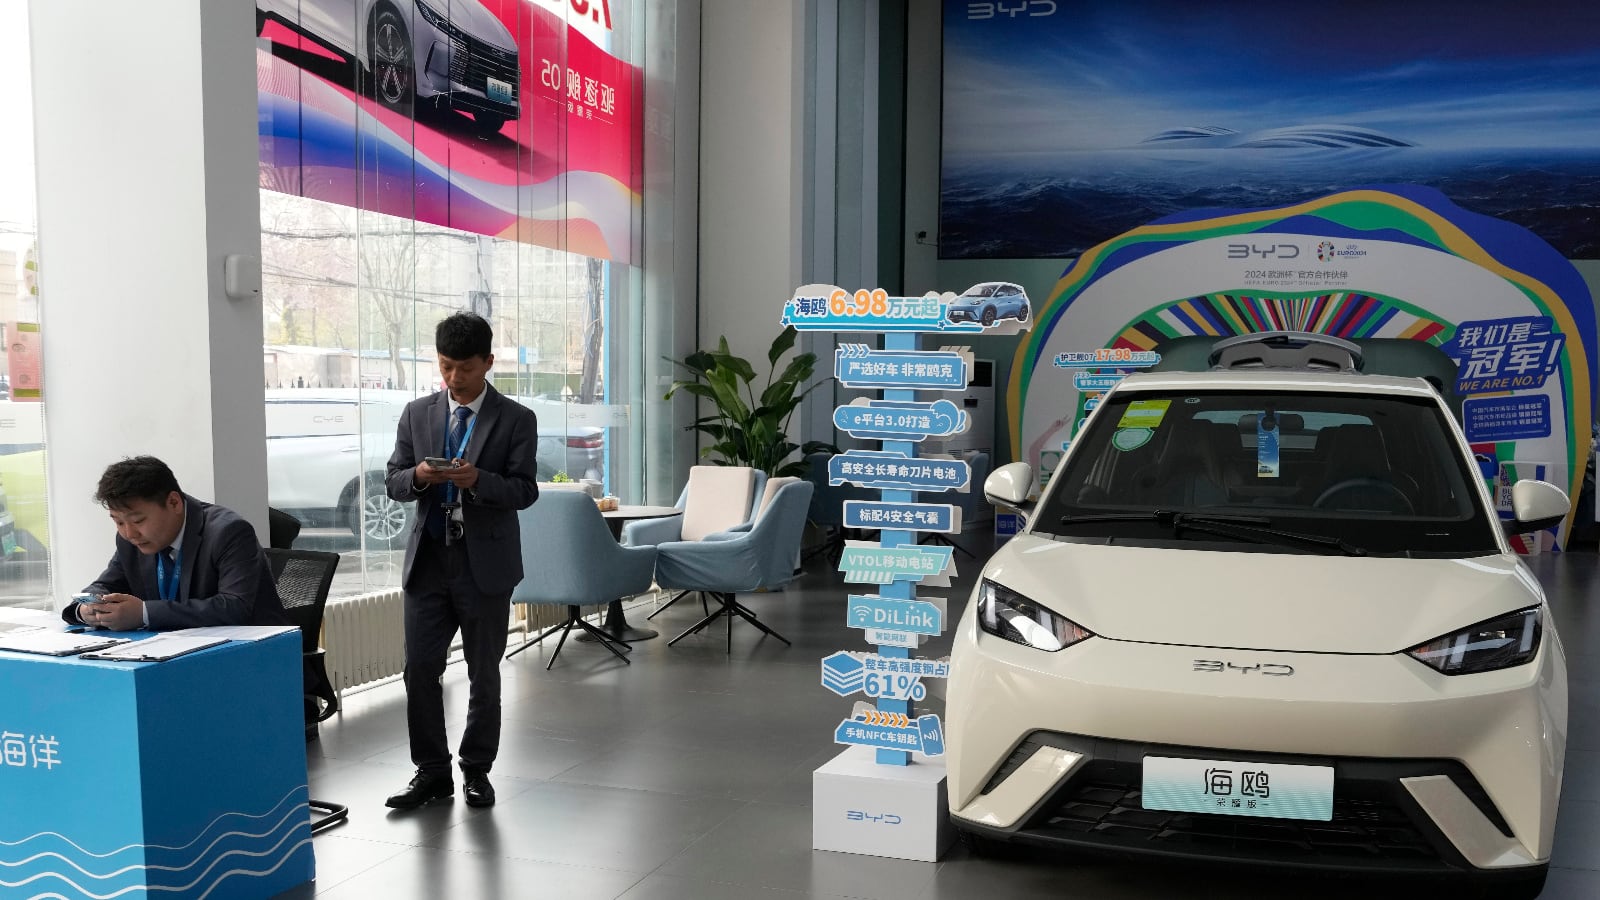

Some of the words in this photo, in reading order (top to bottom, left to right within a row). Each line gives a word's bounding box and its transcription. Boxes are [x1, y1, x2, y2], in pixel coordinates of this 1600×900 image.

[967, 1, 1057, 20] BYD
[1227, 244, 1300, 259] BYD
[1245, 270, 1266, 279] 2024
[1298, 270, 1348, 279] 官方合作伙伴
[1459, 322, 1532, 348] 我们是
[849, 361, 898, 376] 严选好车
[901, 362, 953, 378] 非常鸥克
[1460, 381, 1480, 391] WE
[1482, 378, 1508, 389] ARE
[854, 413, 931, 429] e平台3.0打造
[841, 461, 957, 480] 高安全长寿命刀片电池
[859, 508, 939, 525] 标配4安全气囊
[849, 554, 934, 571] VTOL移动电站
[874, 607, 934, 628] DiLink
[1193, 659, 1295, 677] BYD
[864, 672, 925, 699] 61%
[845, 727, 918, 745] 手机NFC车钥匙
[1203, 767, 1270, 798] 海鸥
[847, 810, 902, 825] BYD
